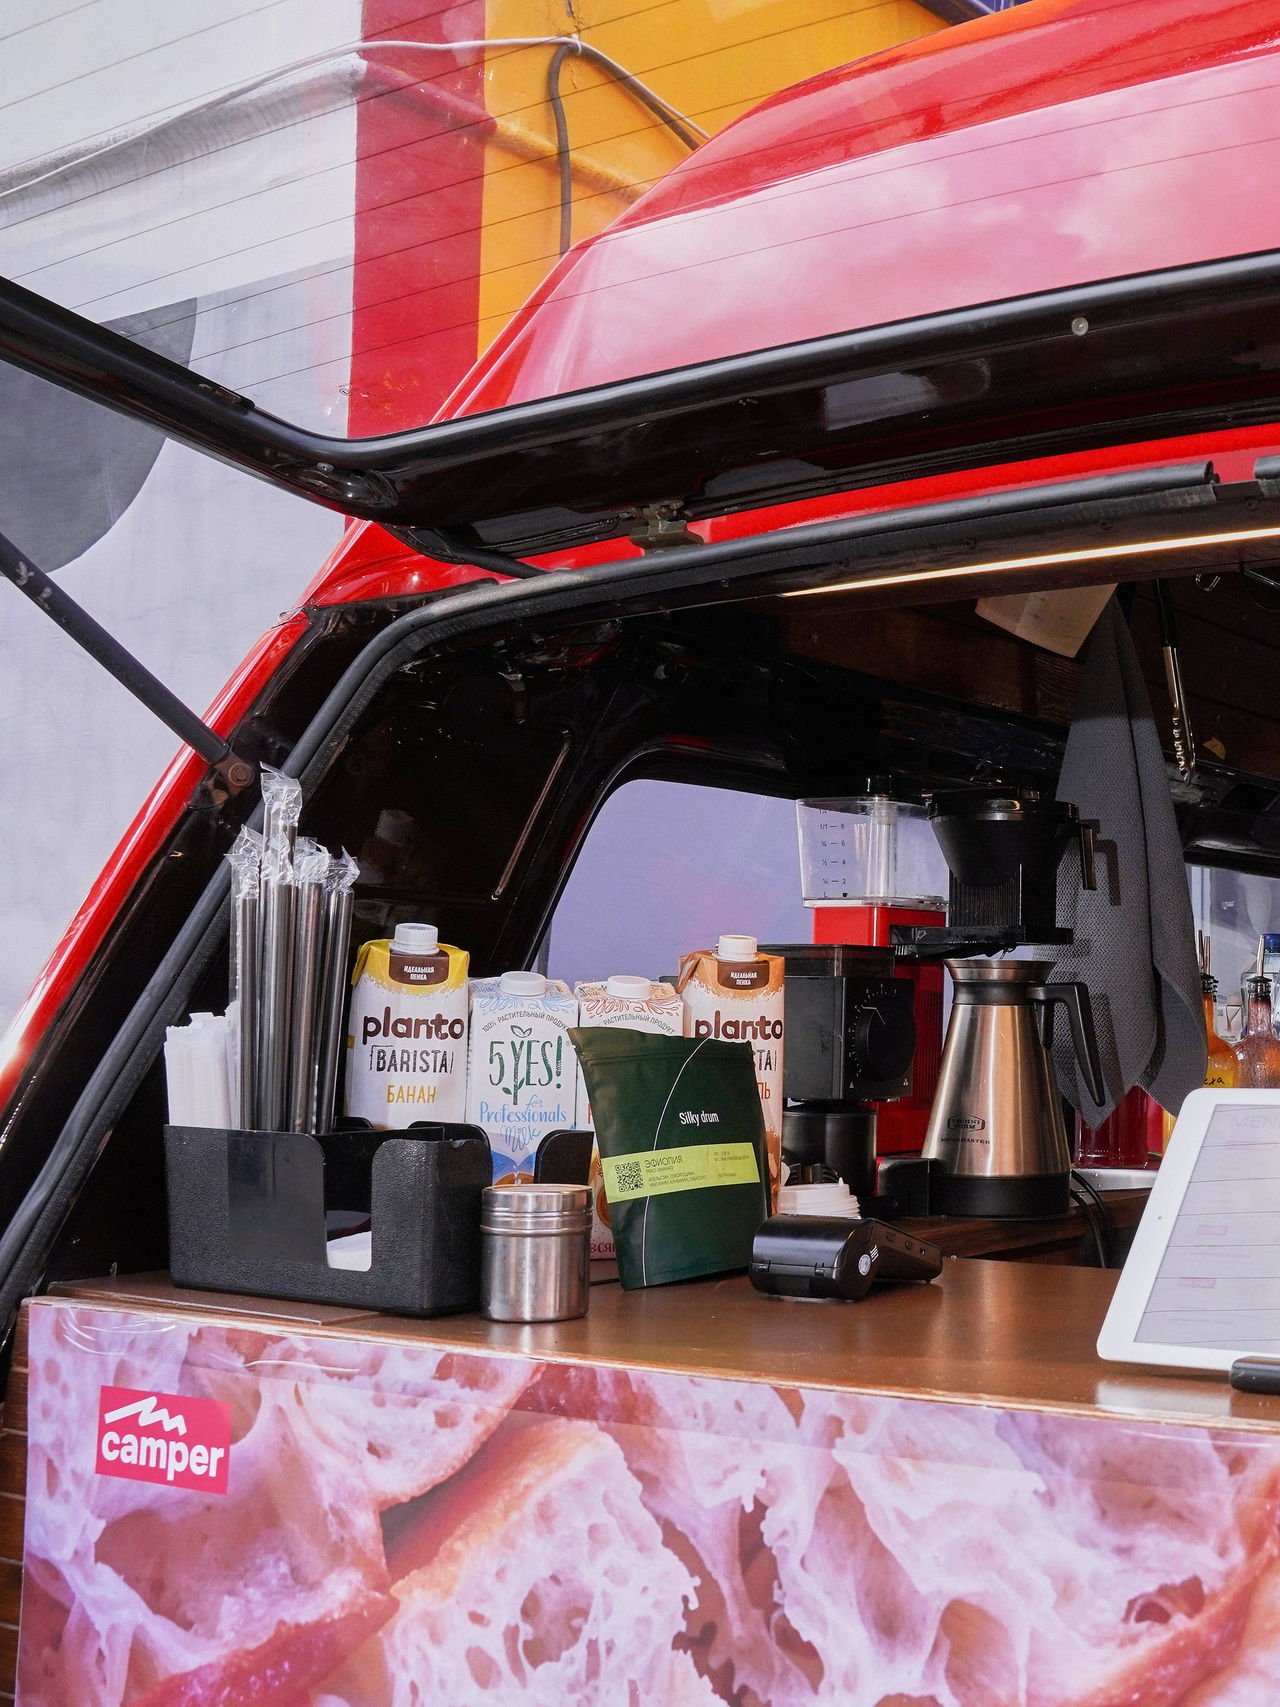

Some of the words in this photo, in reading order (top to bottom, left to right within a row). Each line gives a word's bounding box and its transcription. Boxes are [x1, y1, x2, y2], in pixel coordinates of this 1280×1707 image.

[403, 965, 435, 974] ИДЕАЛЬНАЯ
[410, 973, 428, 981] ПЕНКА
[730, 972, 758, 980] ИДЕАЛЬНАЯ
[735, 978, 752, 986] ПЕНКА
[362, 1006, 465, 1046] planto
[482, 1020, 498, 1033] 100%
[497, 1010, 545, 1024] РАСТИТЕЛЬНЫЙ
[545, 1014, 568, 1032] ПРОДУК
[603, 1013, 650, 1026] РАСТИТЕЛЬНЫЙ
[650, 1017, 675, 1035] ПРОДУКТ
[694, 1010, 783, 1040] planto
[376, 1048, 448, 1074] BARISTA
[489, 1040, 505, 1086] 5
[510, 1036, 562, 1105] YES!
[386, 1084, 437, 1104] БАНАН
[525, 1094, 543, 1114] for
[480, 1101, 567, 1123] Professionals
[679, 1110, 700, 1126] Silky
[700, 1110, 720, 1123] drum
[499, 1124, 542, 1153] Milk
[644, 1155, 684, 1169] ЭФИОПИЯ
[102, 1431, 225, 1481] camper
